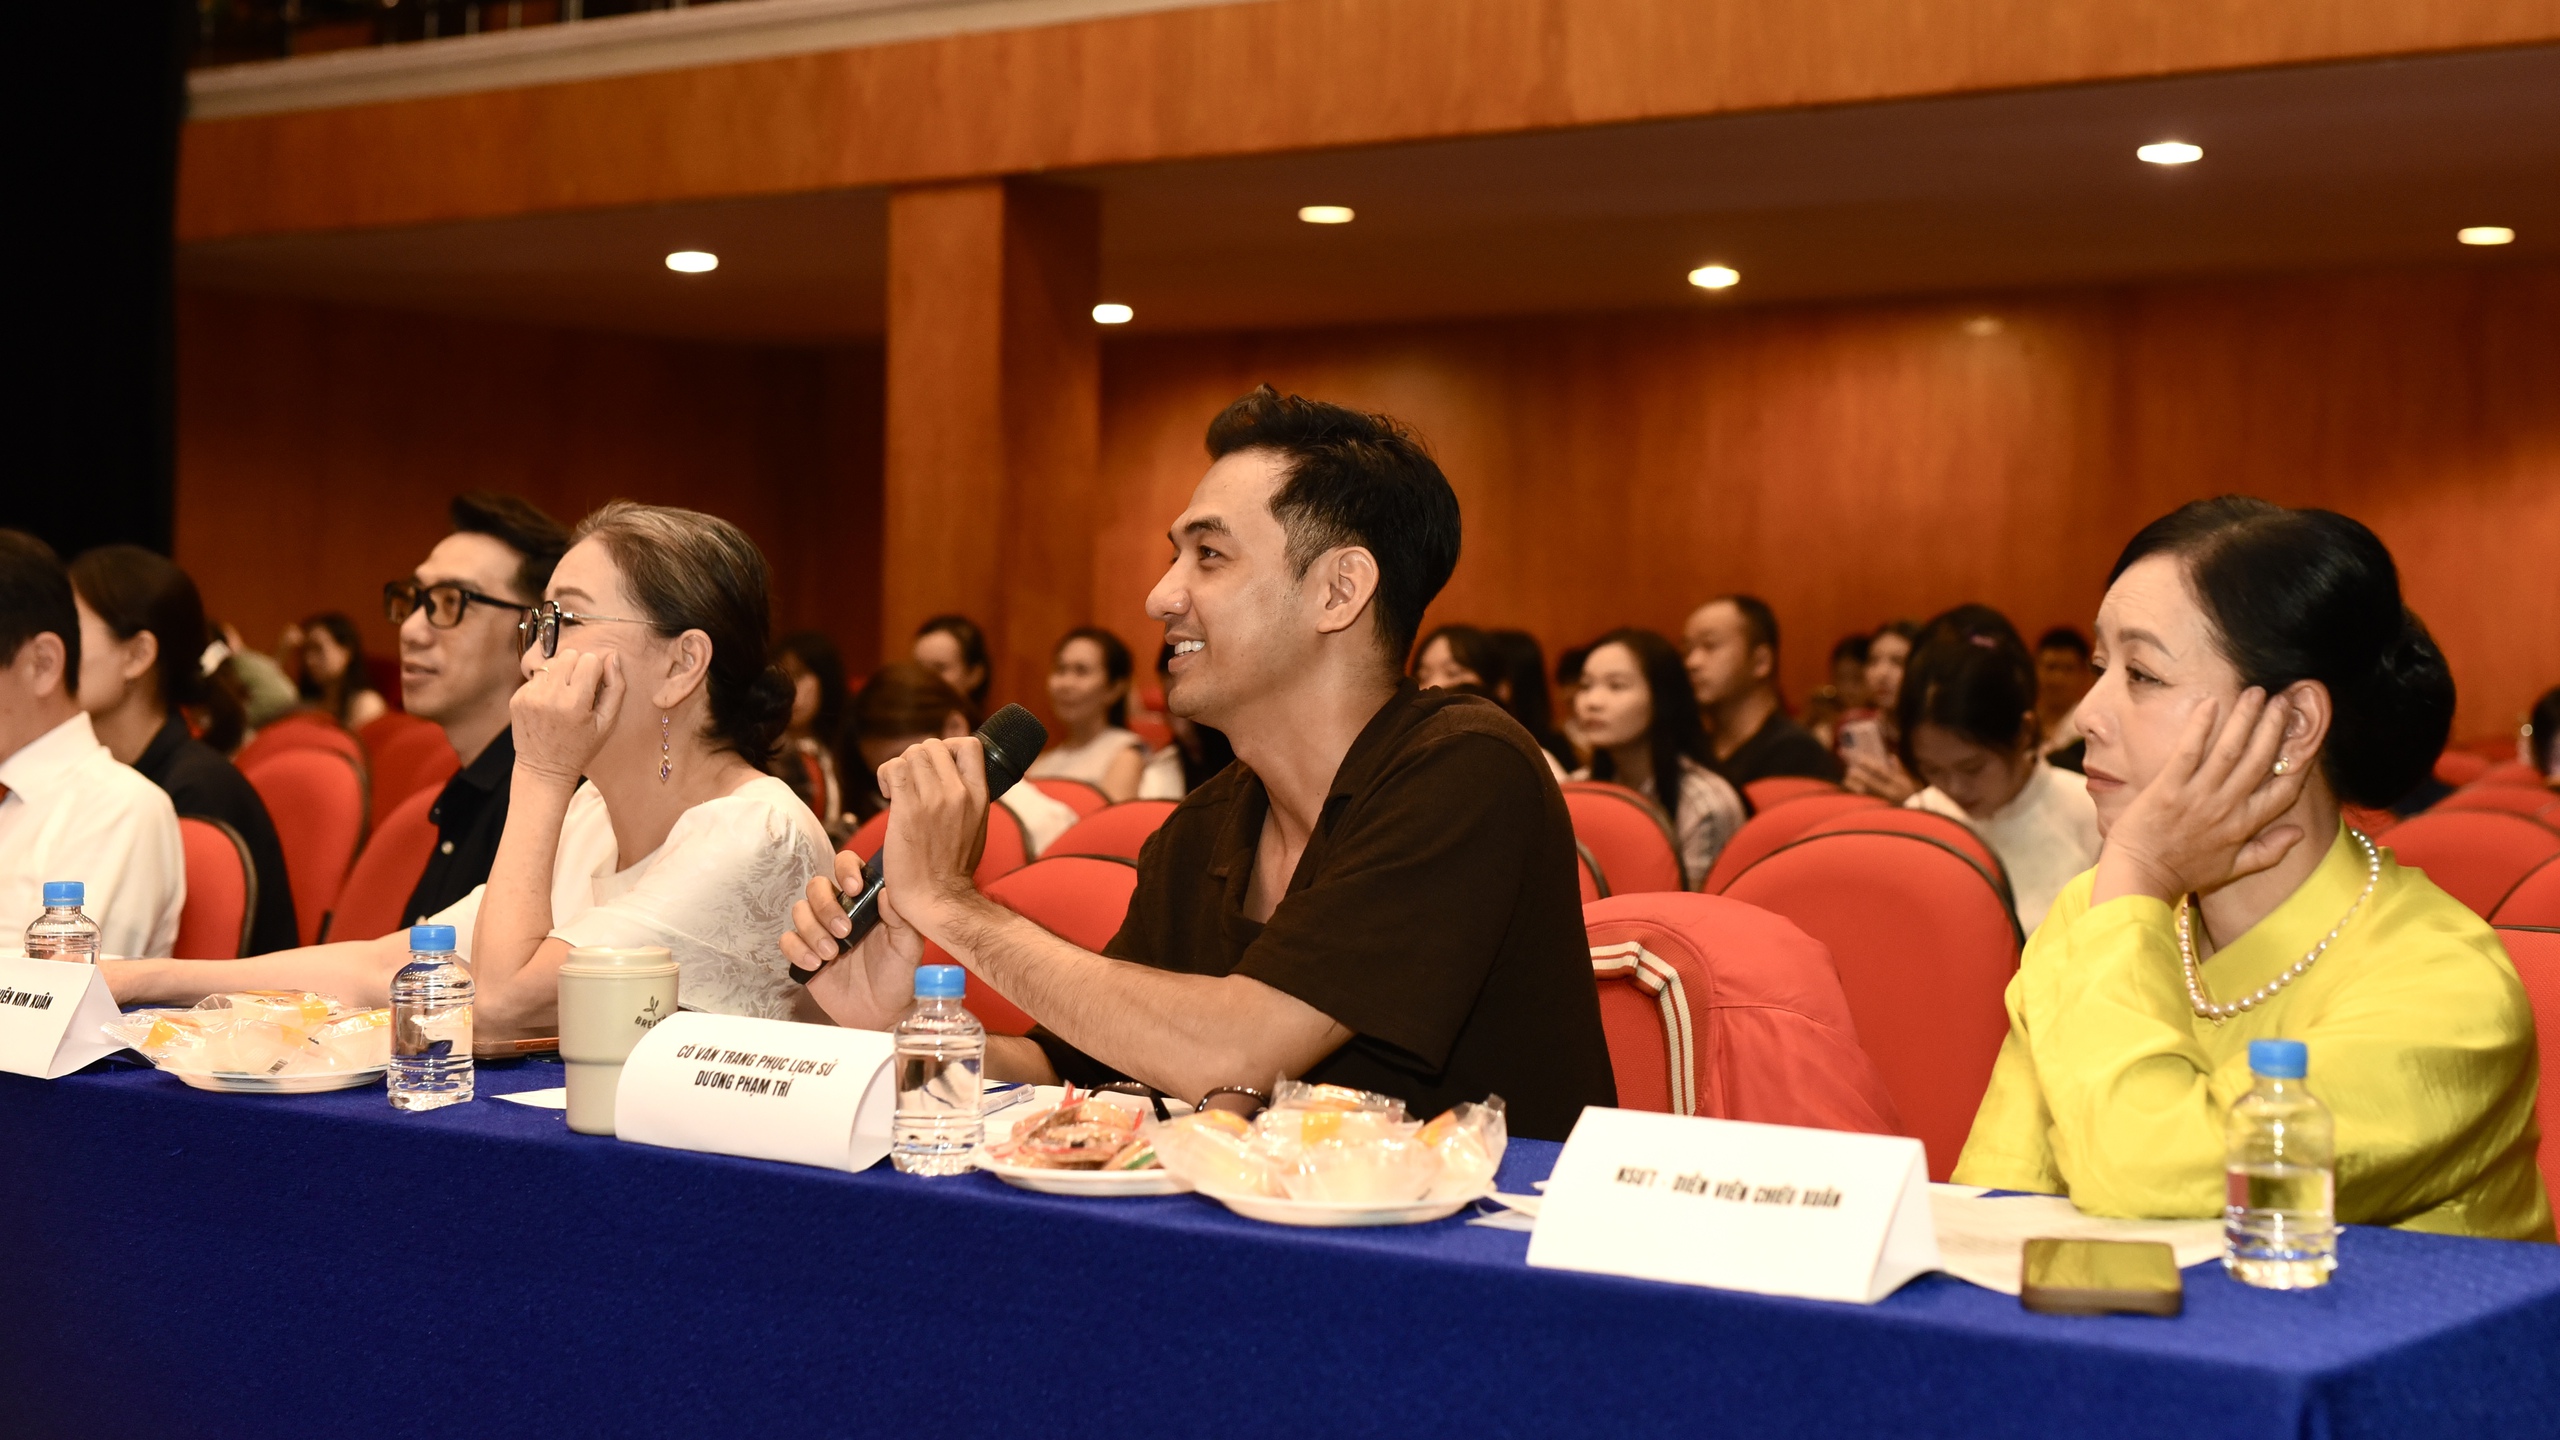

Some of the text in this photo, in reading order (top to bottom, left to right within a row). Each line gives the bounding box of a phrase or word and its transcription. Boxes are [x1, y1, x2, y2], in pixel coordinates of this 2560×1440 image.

[12, 992, 32, 1007] KIM
[29, 992, 54, 1010] XUÂN
[719, 1050, 758, 1066] TRANG
[755, 1055, 790, 1073] PHỤC
[788, 1059, 818, 1076] LỊCH
[816, 1058, 838, 1076] SỬ
[694, 1070, 795, 1097] DƯƠNG PHẠM TRÍ
